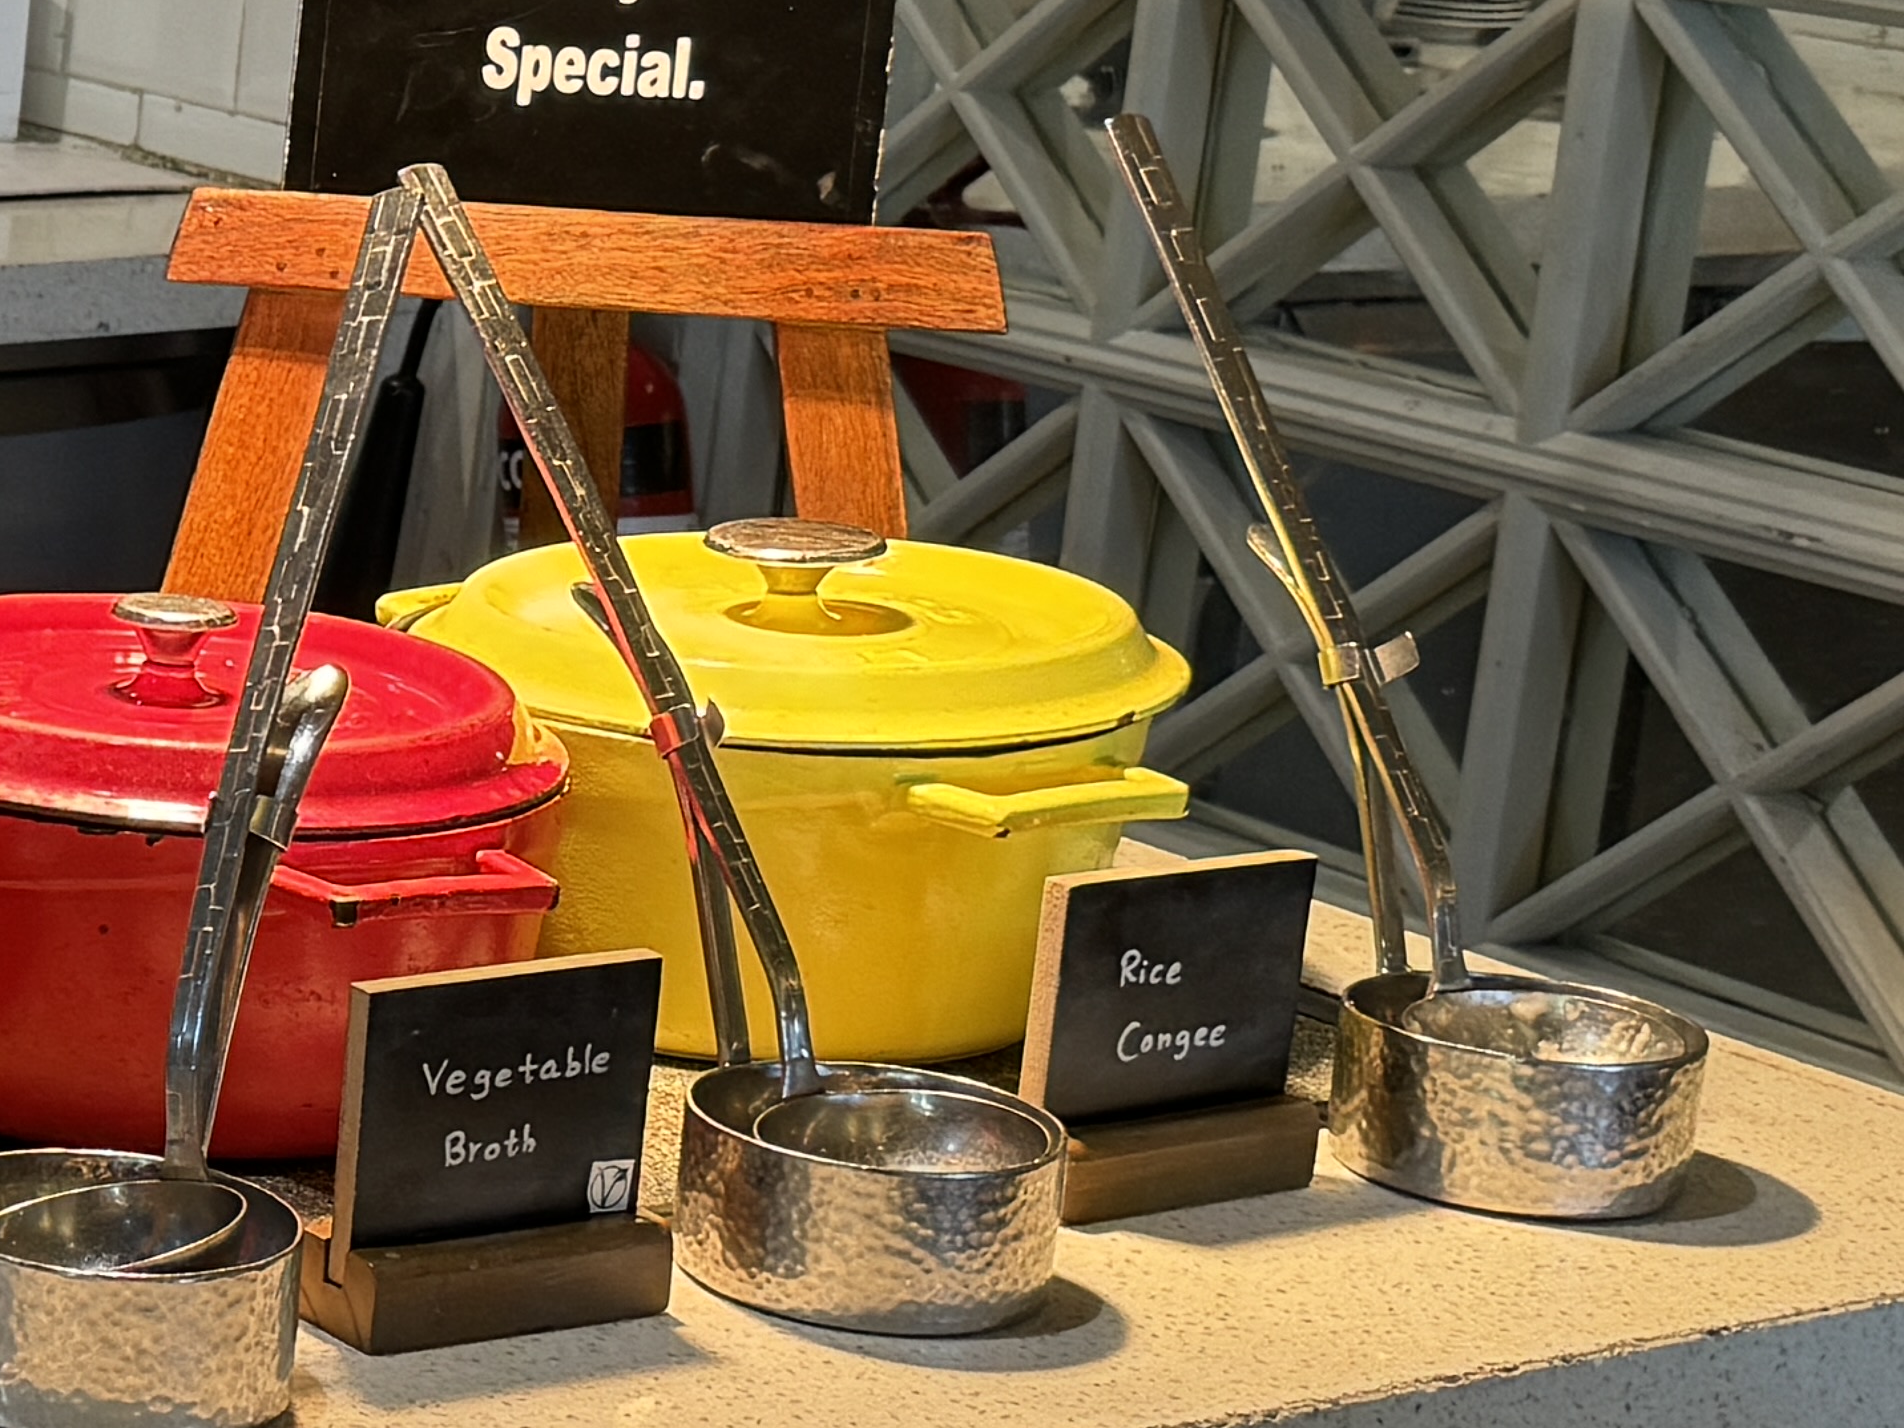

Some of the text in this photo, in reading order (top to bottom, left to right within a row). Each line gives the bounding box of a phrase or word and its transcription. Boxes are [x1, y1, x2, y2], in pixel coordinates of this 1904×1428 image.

[481, 26, 706, 107] Special.
[1119, 948, 1183, 988] Rice
[1116, 1021, 1227, 1062] Congee
[422, 1043, 611, 1101] Vegetable
[444, 1122, 538, 1168] Broth
